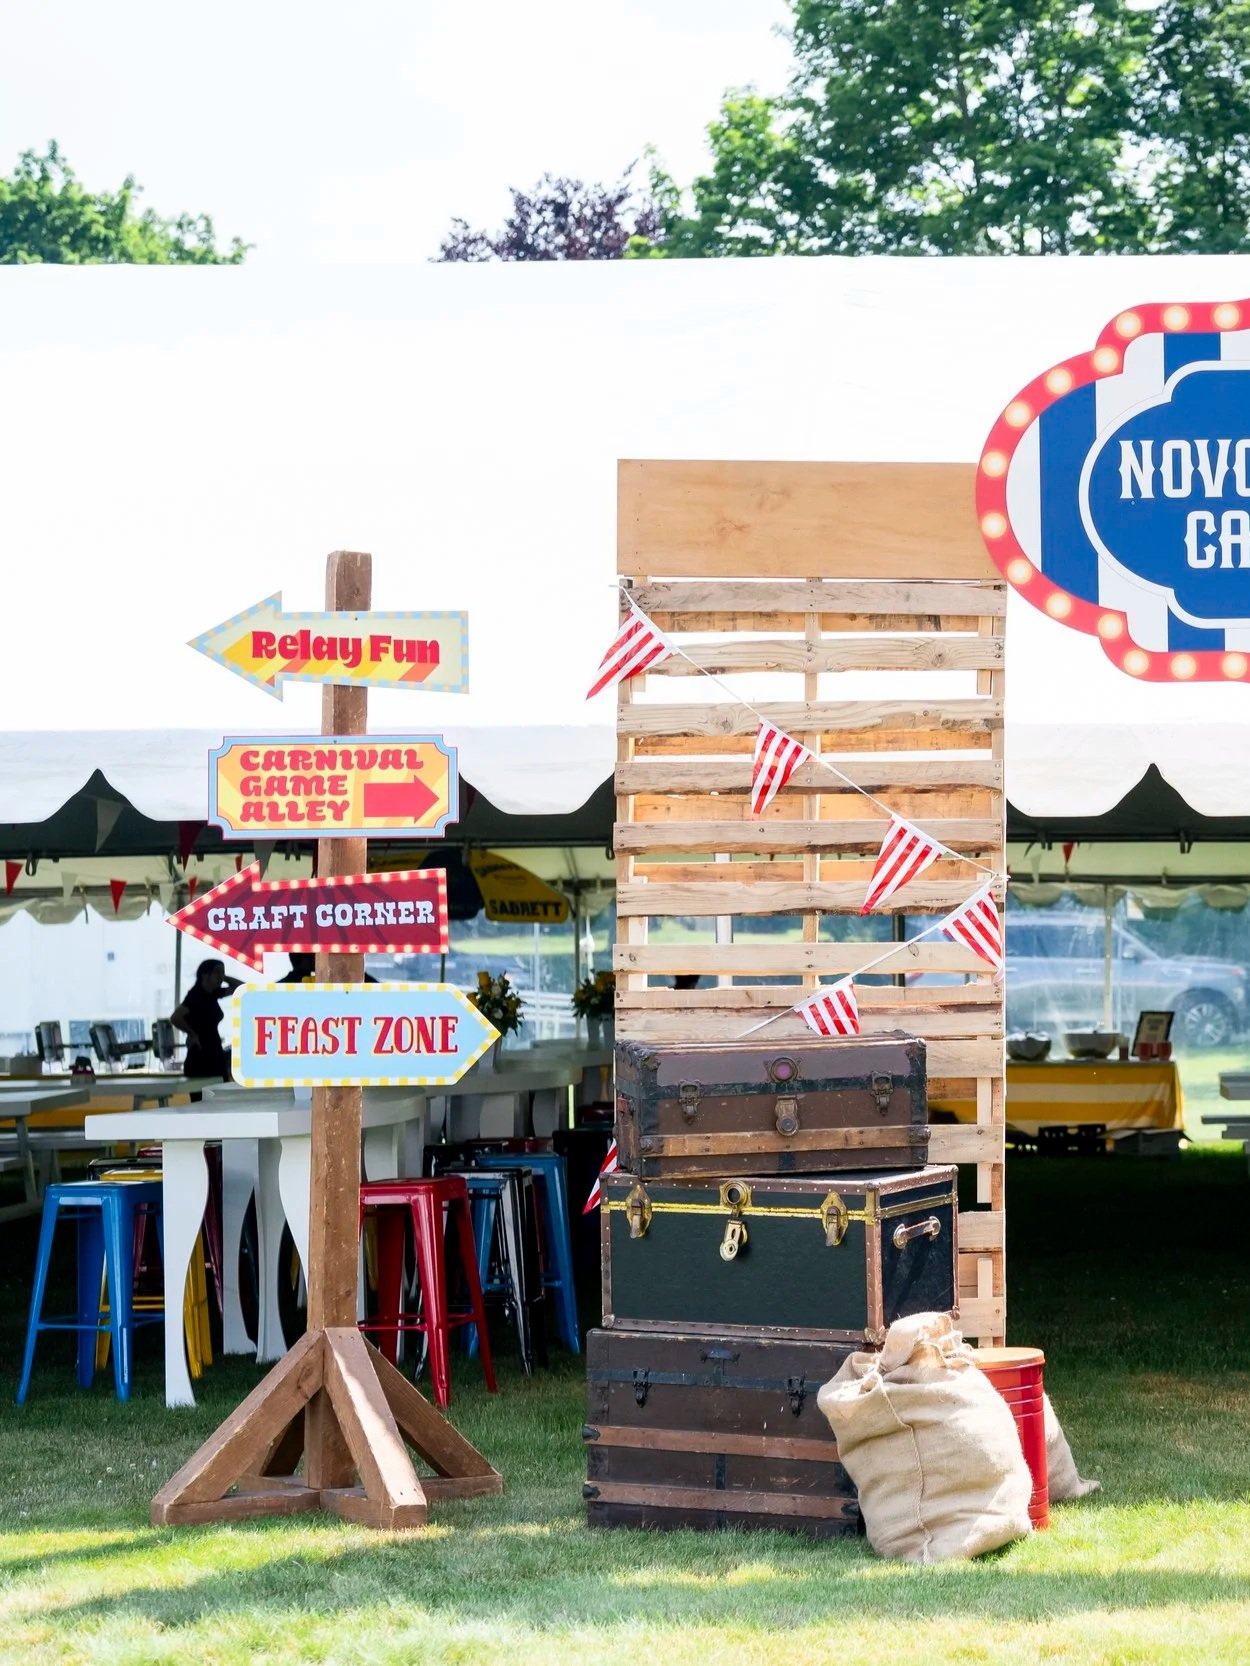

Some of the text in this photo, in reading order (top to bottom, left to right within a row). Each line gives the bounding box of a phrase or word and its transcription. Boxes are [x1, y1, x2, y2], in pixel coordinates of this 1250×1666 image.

[251, 629, 440, 669] Relay Fun
[239, 748, 424, 771] CARNIVAL
[239, 774, 348, 797] GAME
[239, 799, 350, 822] ALLEY
[207, 900, 435, 931] CRAFT CORNER
[254, 1015, 459, 1056] FEAST ZONE
